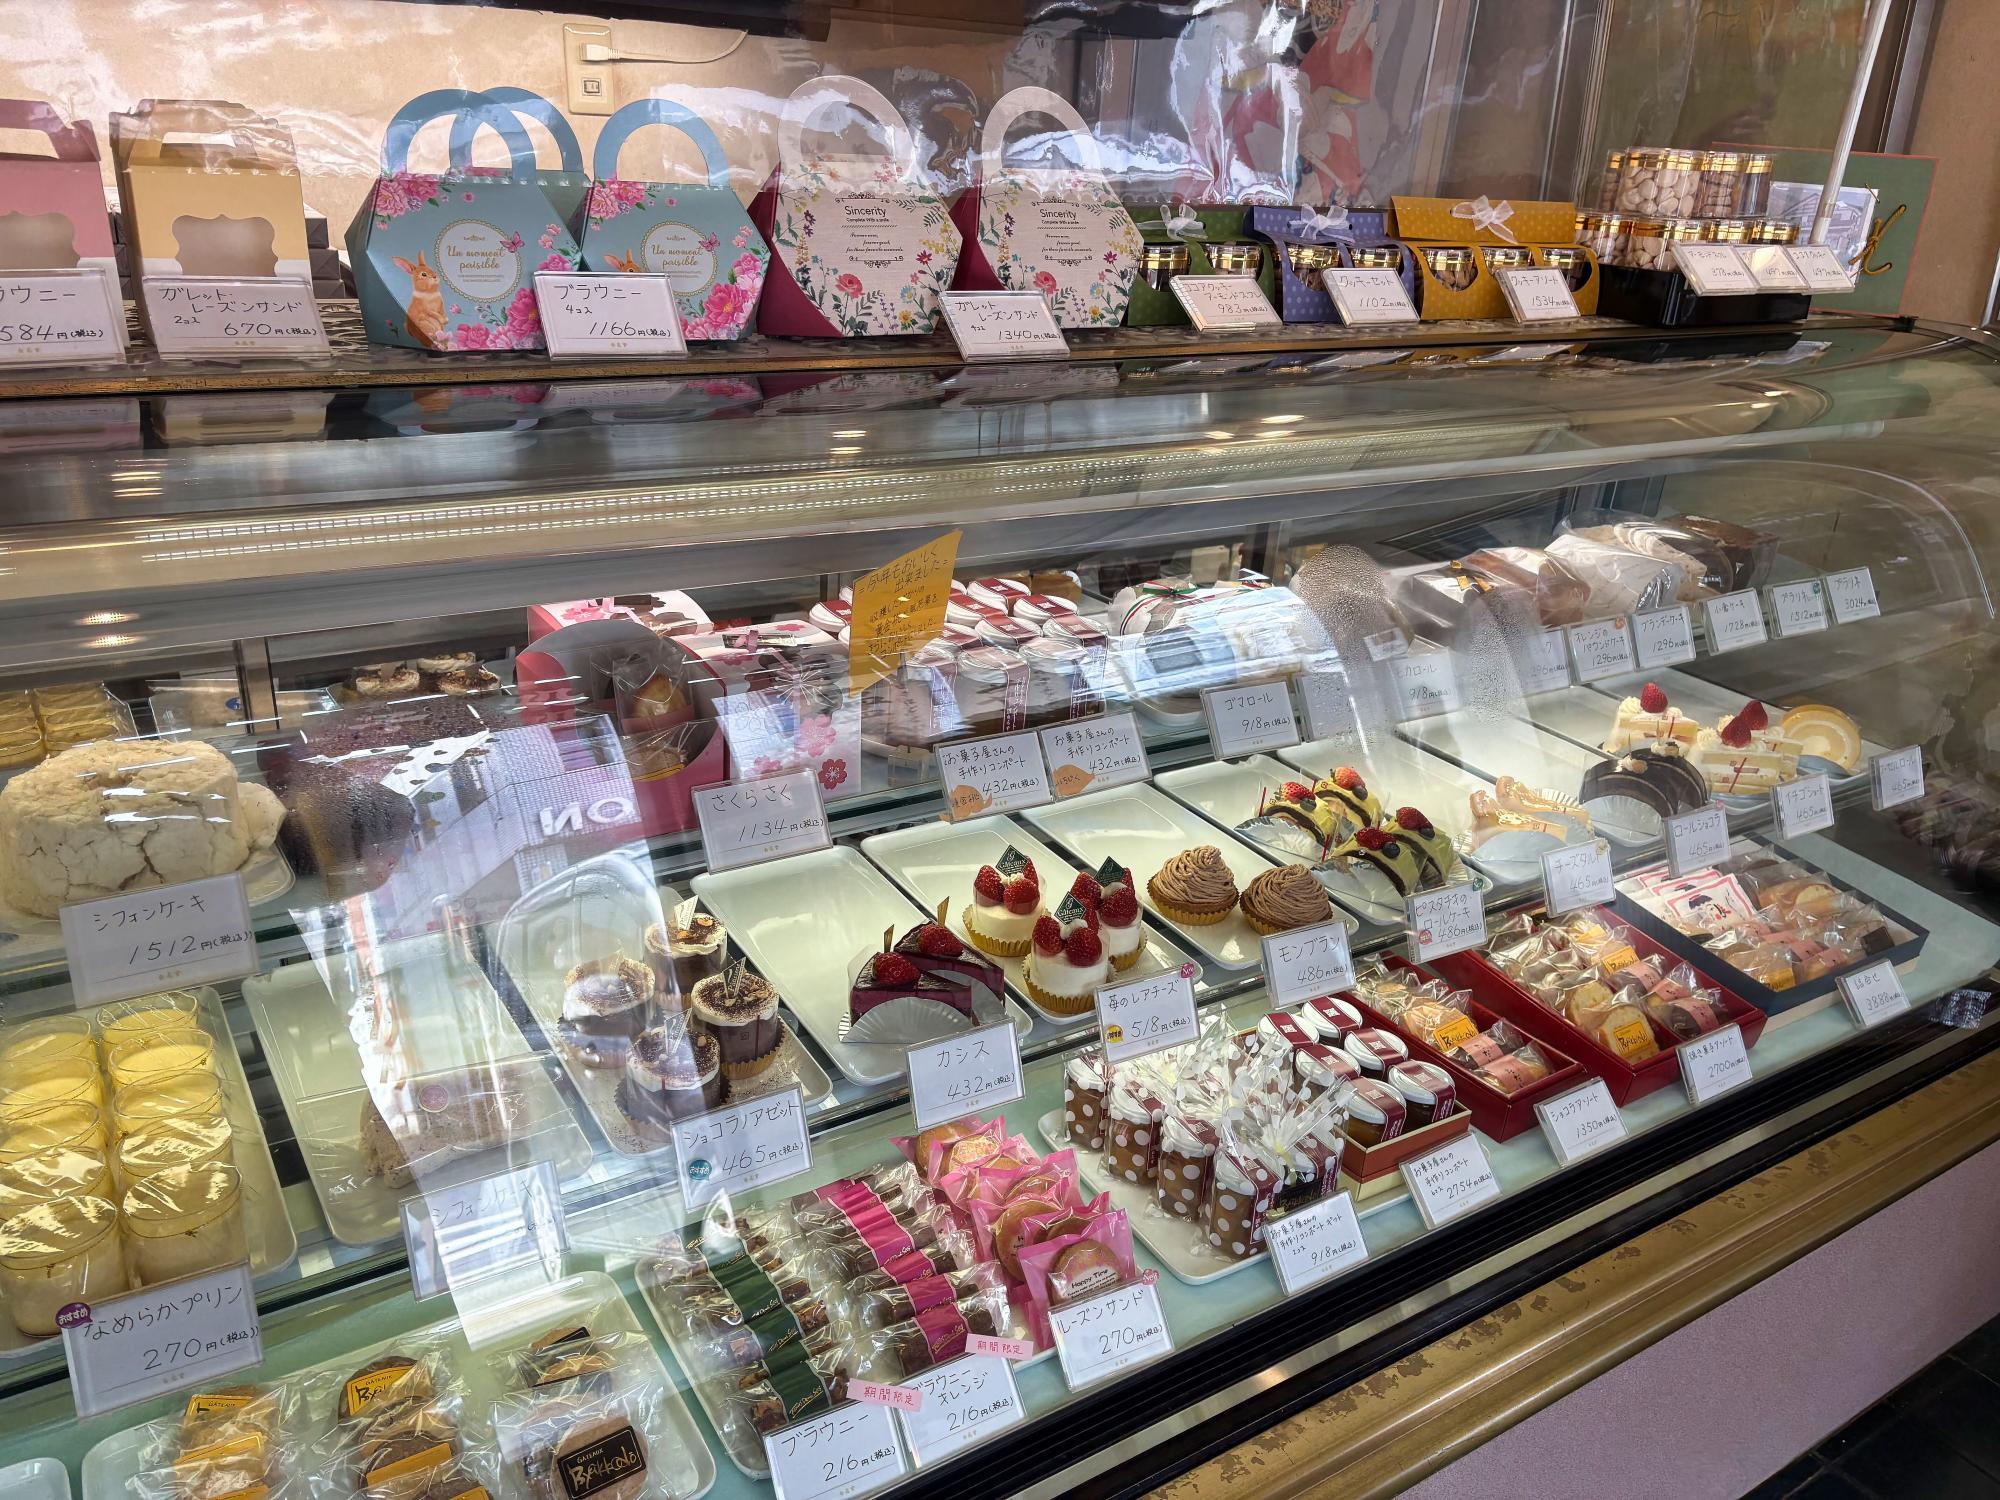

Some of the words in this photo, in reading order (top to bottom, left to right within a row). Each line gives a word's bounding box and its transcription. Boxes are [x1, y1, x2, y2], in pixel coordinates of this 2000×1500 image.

[845, 206, 887, 217] Sincerity
[1040, 209, 1076, 220] Sincerity
[447, 245, 463, 257] Un
[466, 247, 506, 257] moment
[651, 244, 665, 255] Un
[669, 247, 703, 255] moment
[460, 257, 499, 273] paisible
[663, 256, 698, 270] paisible
[159, 286, 232, 301] ガレット
[553, 284, 642, 300] ブラウニー
[191, 301, 302, 314] レーズンサンド
[955, 301, 997, 311] ガレット
[979, 311, 1038, 321] レーズンサンド
[224, 322, 317, 337] 670円(税込)
[1055, 727, 1114, 747] お菓子屋さんの
[1067, 737, 1129, 758] 手作りコンポート
[943, 745, 1014, 766] お菓子屋さんの
[958, 756, 1026, 779] 手作りコンポート
[712, 784, 791, 812] さくらさく
[739, 818, 824, 842] 1134円(税込)
[1674, 813, 1720, 837] ロールショコラ
[1416, 894, 1467, 917] ピスタチオの
[1424, 907, 1470, 930] ロールケーキ
[1279, 936, 1340, 963] モンブラン
[1108, 979, 1180, 1012] 苺のレアチーズ
[937, 1040, 990, 1068] カシス
[947, 1073, 1015, 1100] 432円(税込)
[1551, 1092, 1598, 1122] ショコラアソート
[683, 1102, 799, 1143] ショコラノアゼット
[721, 1142, 804, 1175] 465円(税込)
[1413, 1152, 1454, 1178] お菓子屋さんの
[1425, 1158, 1471, 1188] 手作りコンポート
[1071, 1276, 1092, 1288] Happy
[1093, 1269, 1108, 1279] Time
[59, 1308, 89, 1325] おすすめ
[83, 1287, 242, 1341] なめらかプリン
[1056, 1290, 1145, 1335] レーズンサンド
[977, 1339, 1024, 1356] 期間限定
[1099, 1325, 1164, 1356] 270円(税込)
[911, 1368, 971, 1397] ブラウニー
[863, 1386, 915, 1407] 期間限定
[946, 1396, 1014, 1432] 216円(税込)
[780, 1413, 869, 1458] ブラウニー
[822, 1445, 896, 1482] 216円(税込)
